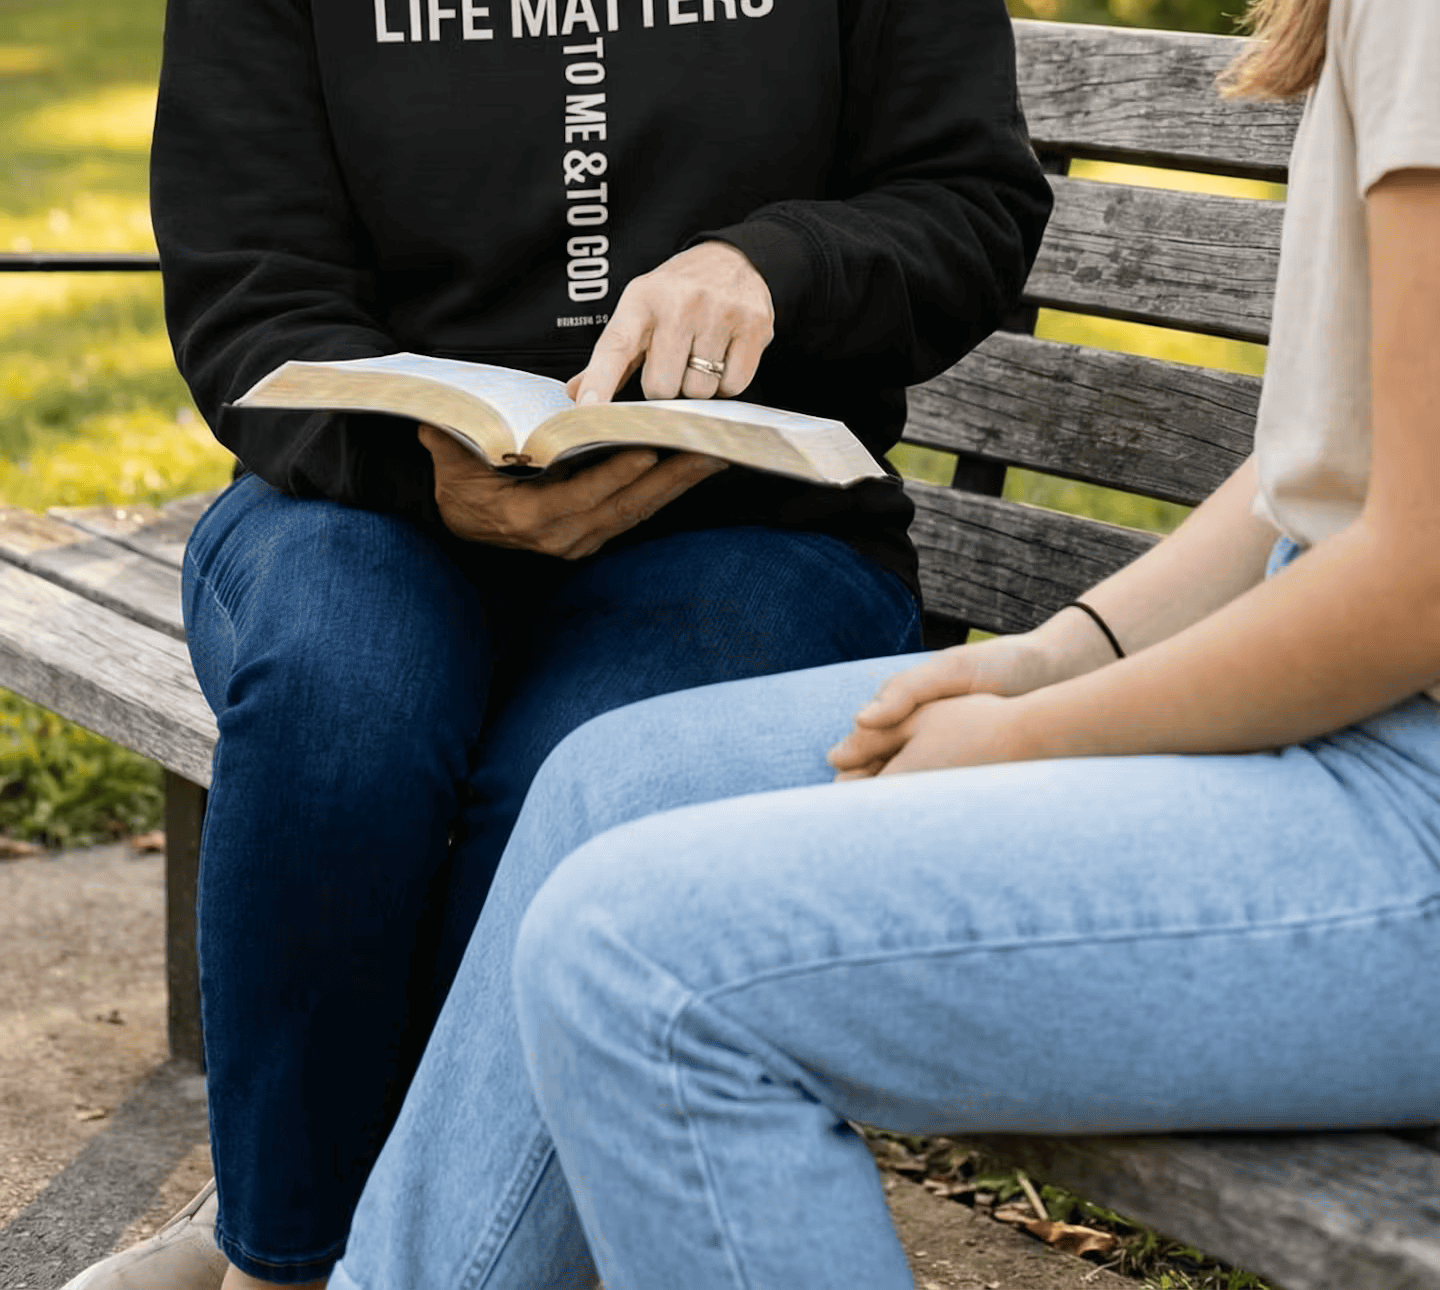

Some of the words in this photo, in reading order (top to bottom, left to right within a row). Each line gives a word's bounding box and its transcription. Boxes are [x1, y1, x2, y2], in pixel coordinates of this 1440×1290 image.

[562, 36, 606, 85] TO
[564, 92, 607, 143] ME
[566, 235, 610, 302] GOD
